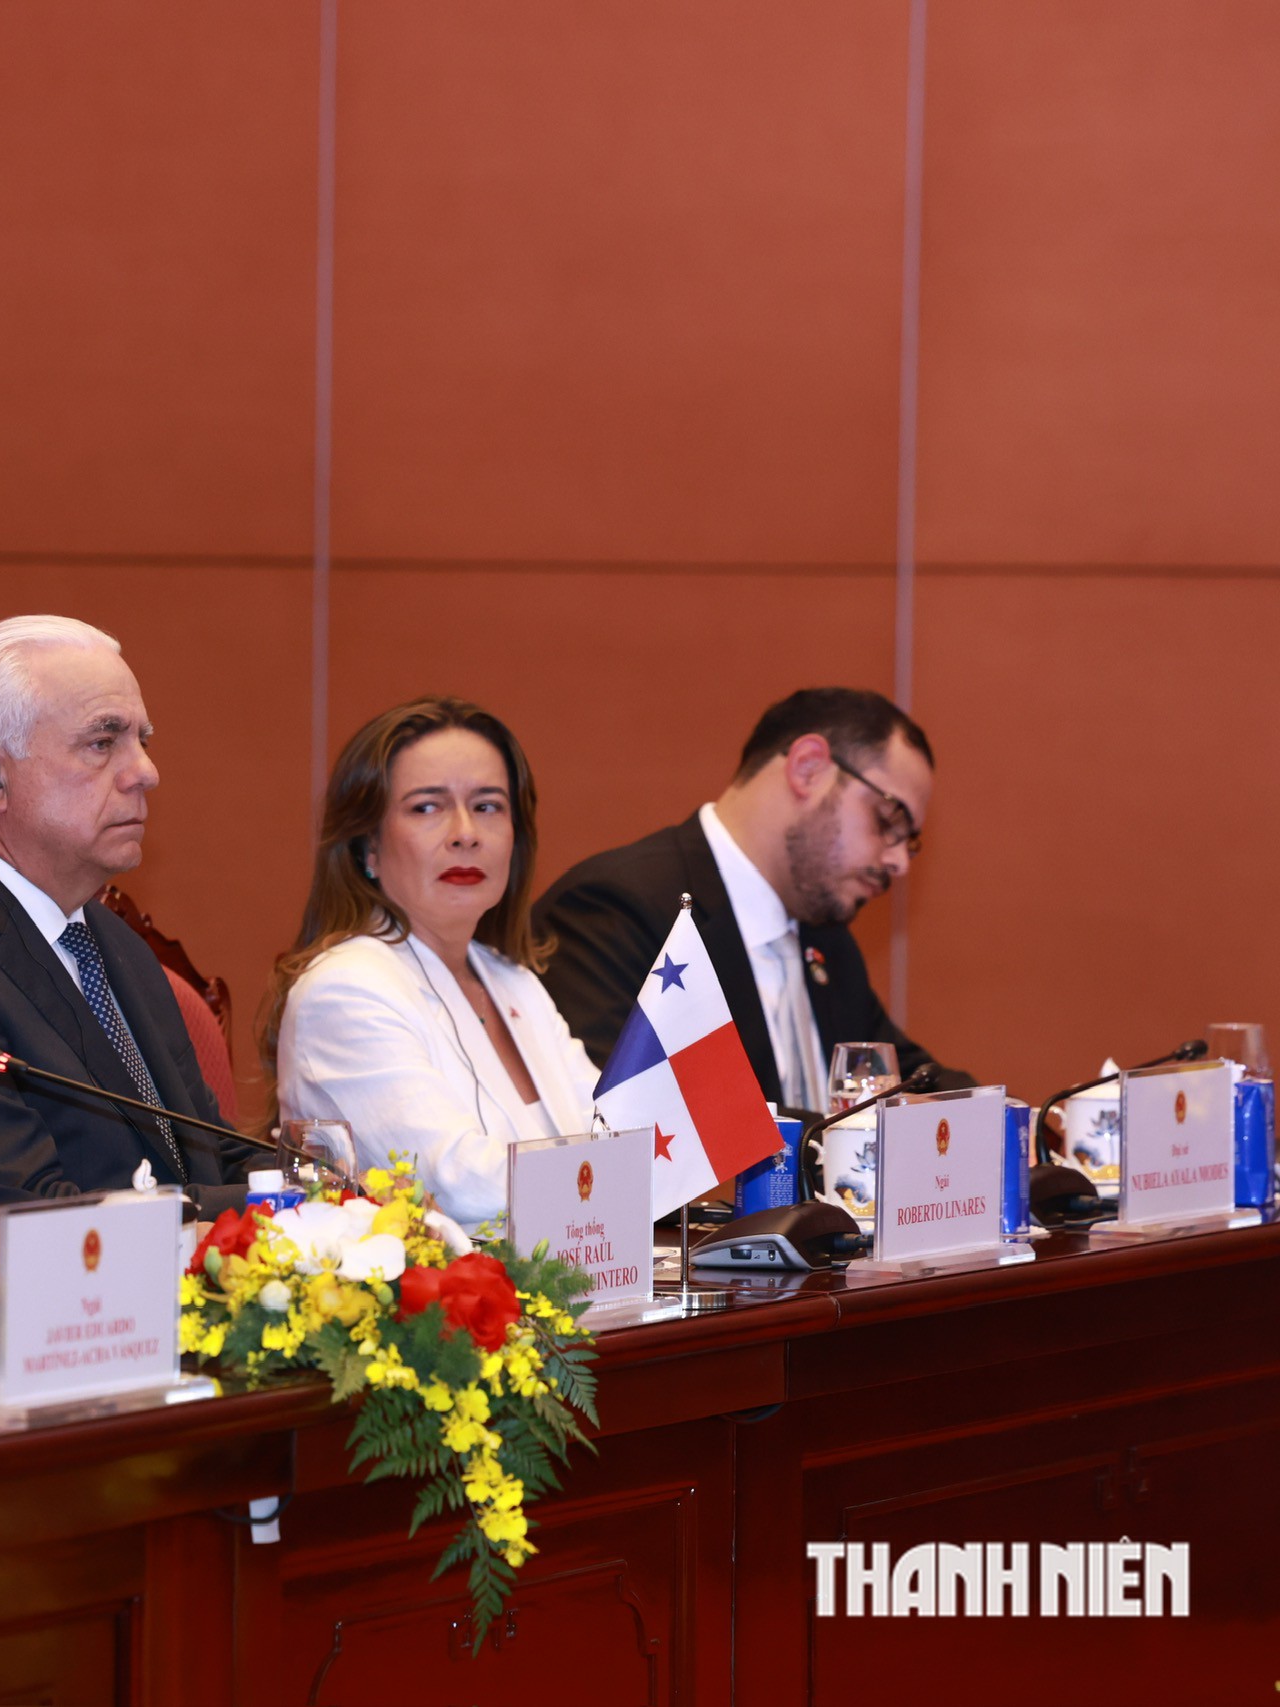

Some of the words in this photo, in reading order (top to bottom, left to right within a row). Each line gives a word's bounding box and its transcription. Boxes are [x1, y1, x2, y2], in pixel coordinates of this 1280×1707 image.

[1131, 1171, 1168, 1192] NUBIELA
[1170, 1167, 1197, 1186] AYALA
[897, 1202, 943, 1226] ROBERTO
[945, 1196, 986, 1219] LINARES
[585, 1216, 605, 1238] thống
[557, 1241, 582, 1269] JOSÉ
[585, 1236, 614, 1265] RAÚL
[582, 1265, 638, 1297] QUINTERO
